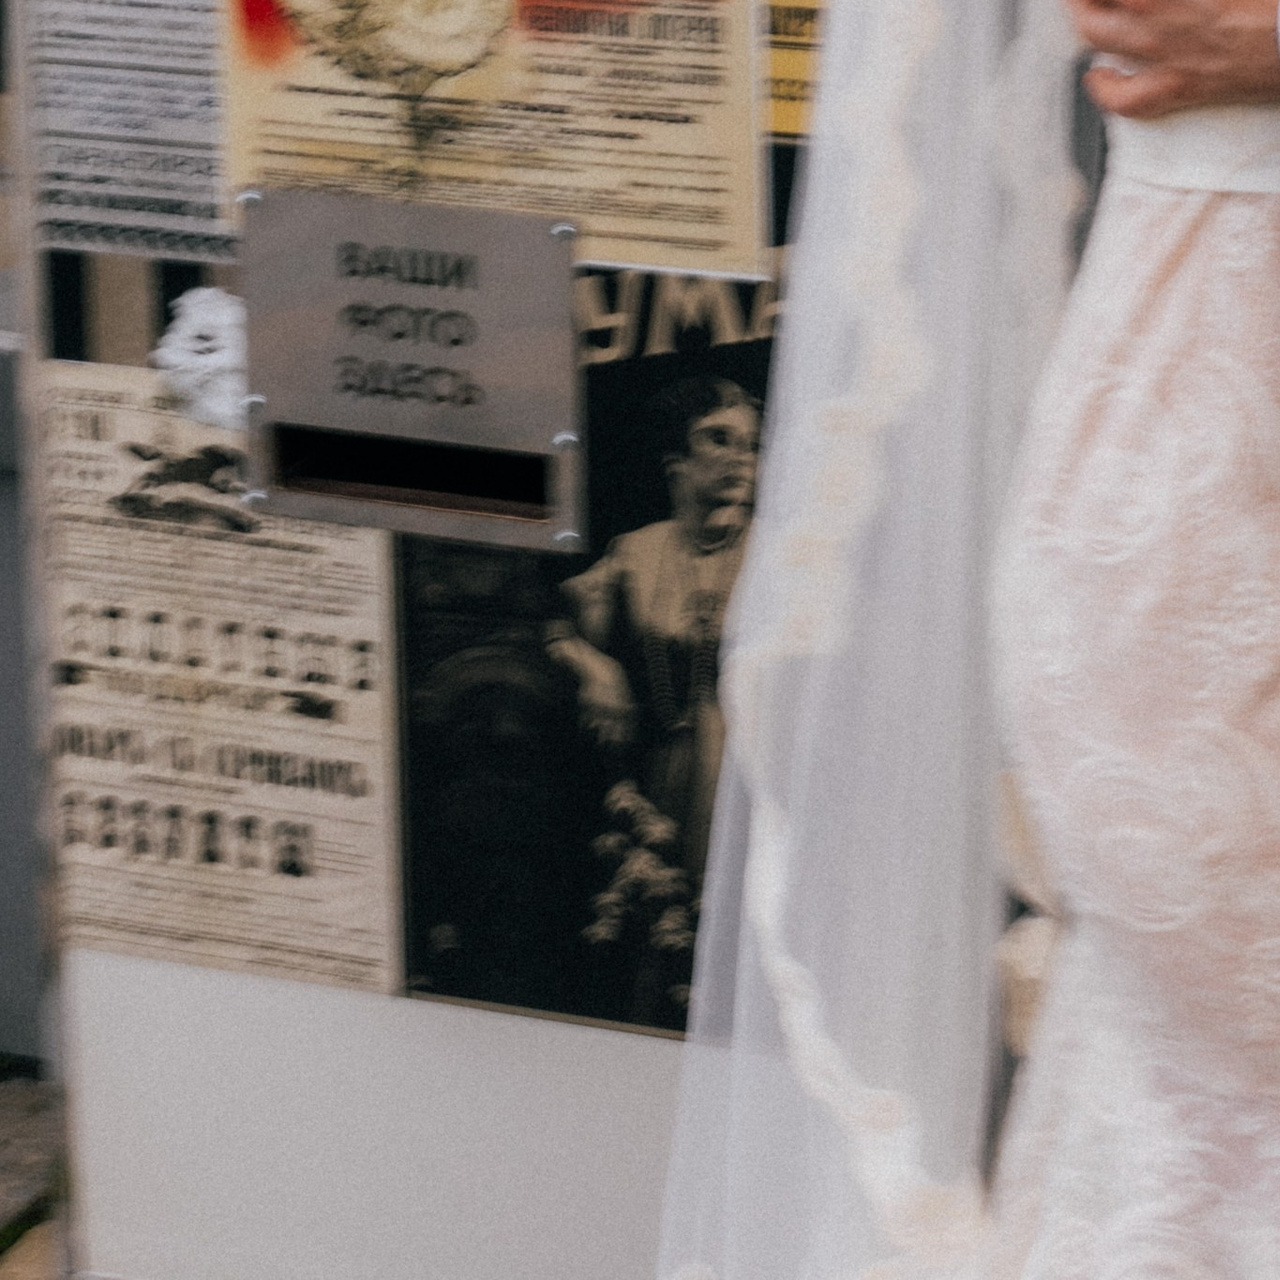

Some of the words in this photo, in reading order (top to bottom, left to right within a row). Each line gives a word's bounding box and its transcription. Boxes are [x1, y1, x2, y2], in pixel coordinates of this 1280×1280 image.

[335, 241, 480, 291] ВАШИ
[339, 301, 479, 348] ФОТО
[333, 353, 485, 407] ЗДЕСЬ
